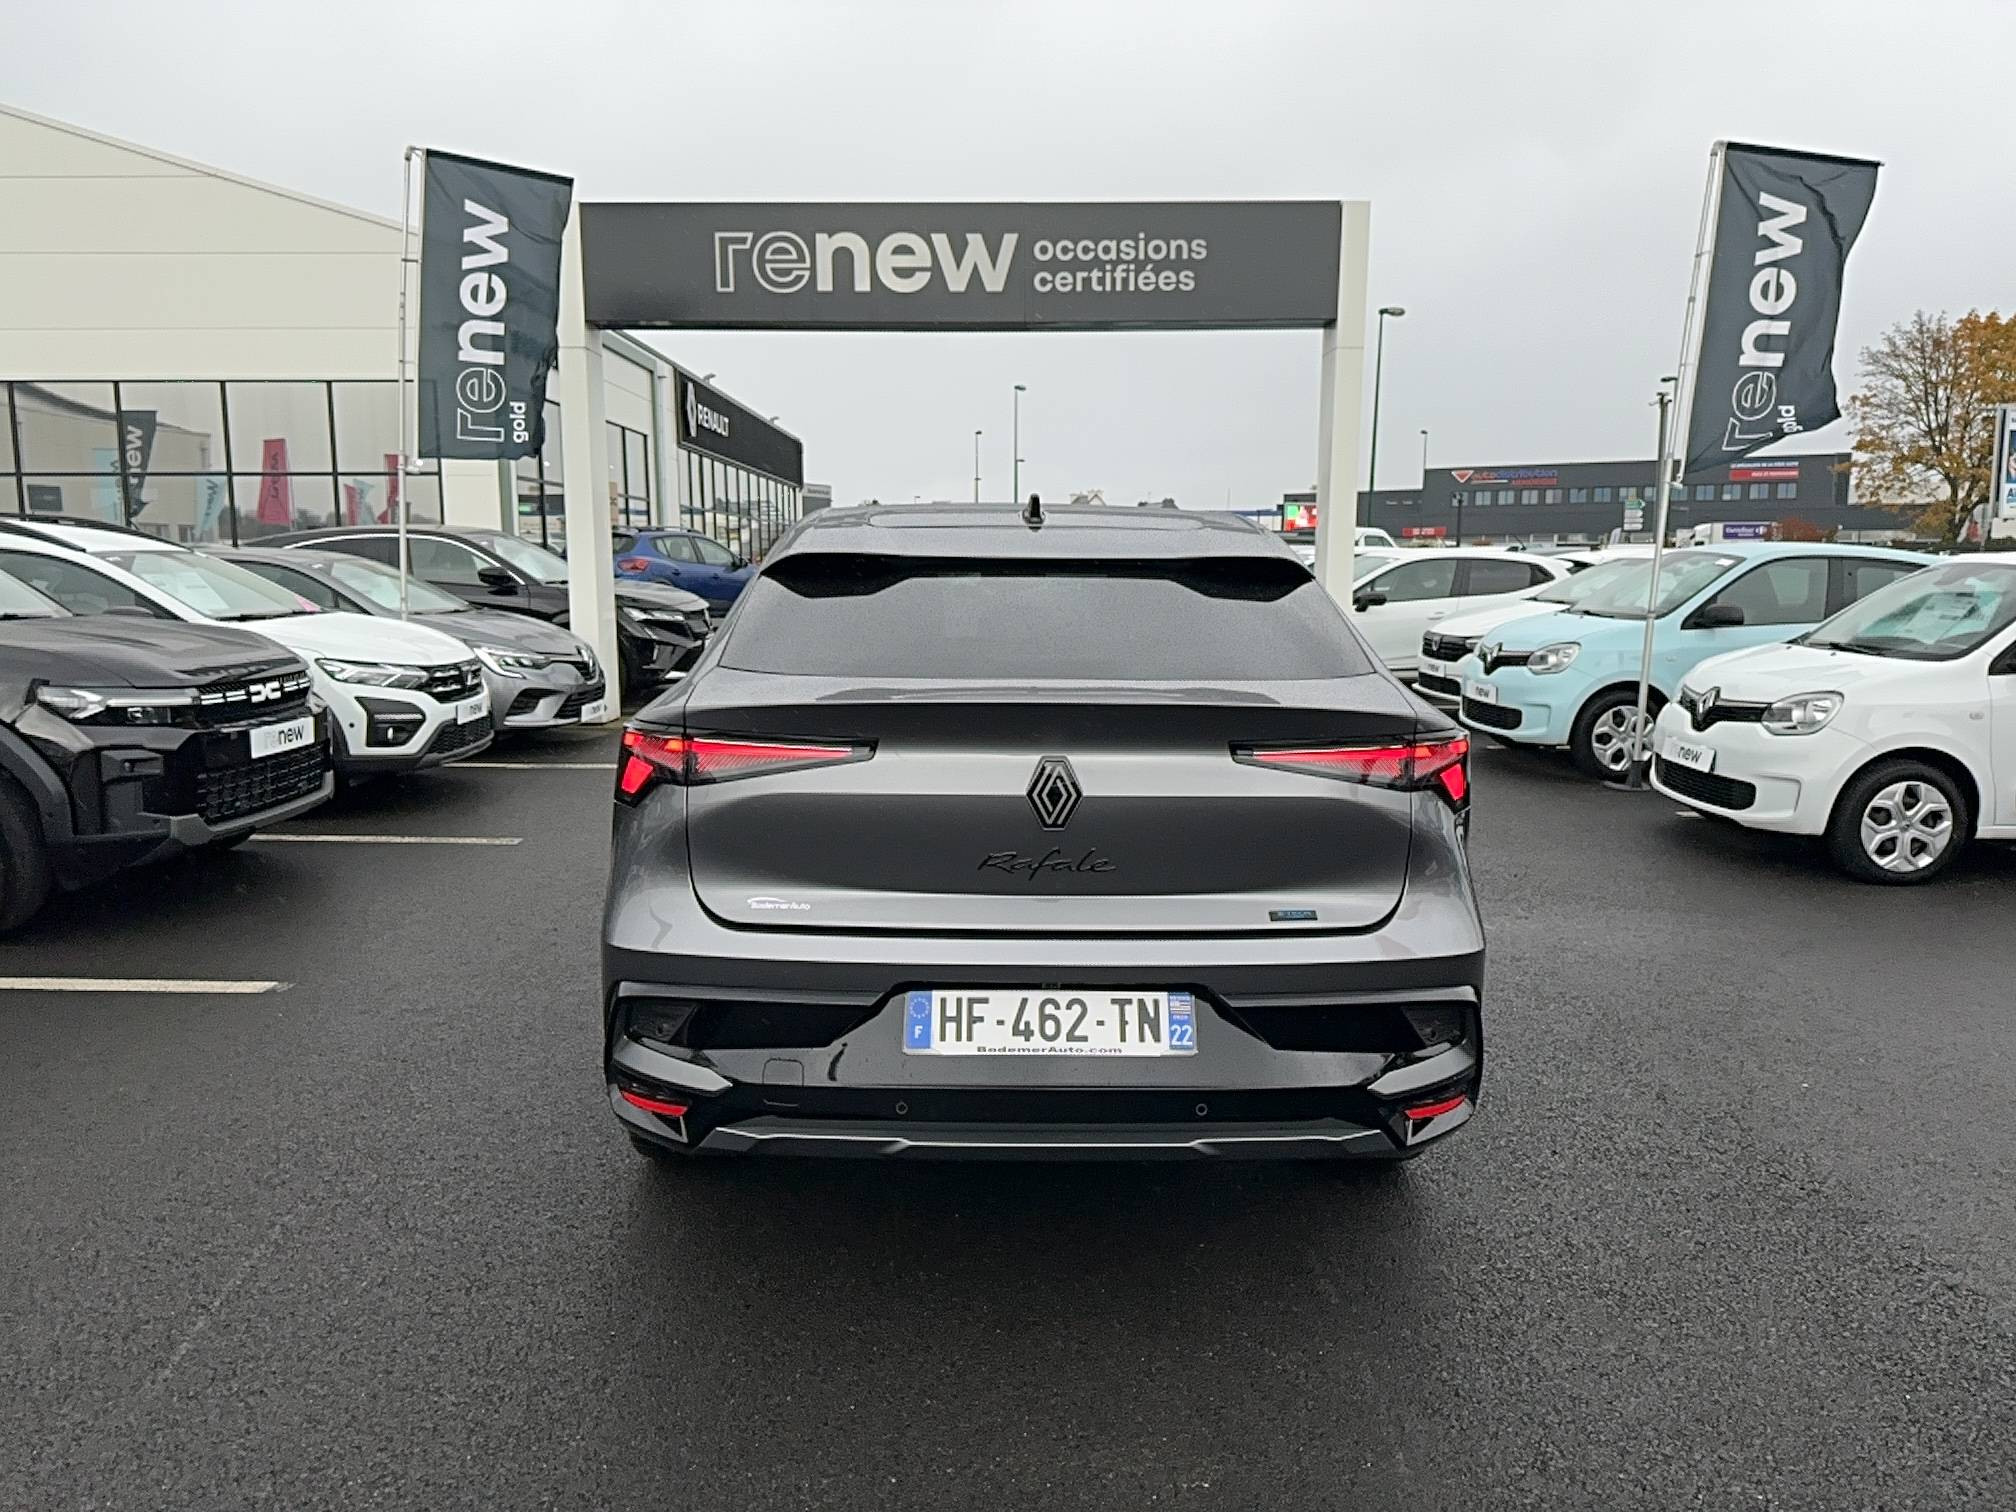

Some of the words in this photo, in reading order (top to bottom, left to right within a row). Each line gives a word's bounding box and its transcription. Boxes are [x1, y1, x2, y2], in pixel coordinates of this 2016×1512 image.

[714, 230, 1019, 294] renew
[1033, 232, 1208, 263] occasions
[1033, 263, 1196, 293] certifiées
[457, 199, 510, 443] renew
[1722, 191, 1808, 451] renew
[509, 400, 530, 444] gold
[976, 847, 1117, 881] Rafale
[914, 1025, 923, 1039] F
[939, 996, 1162, 1043] HF-462-TN
[1170, 1024, 1193, 1046] 22
